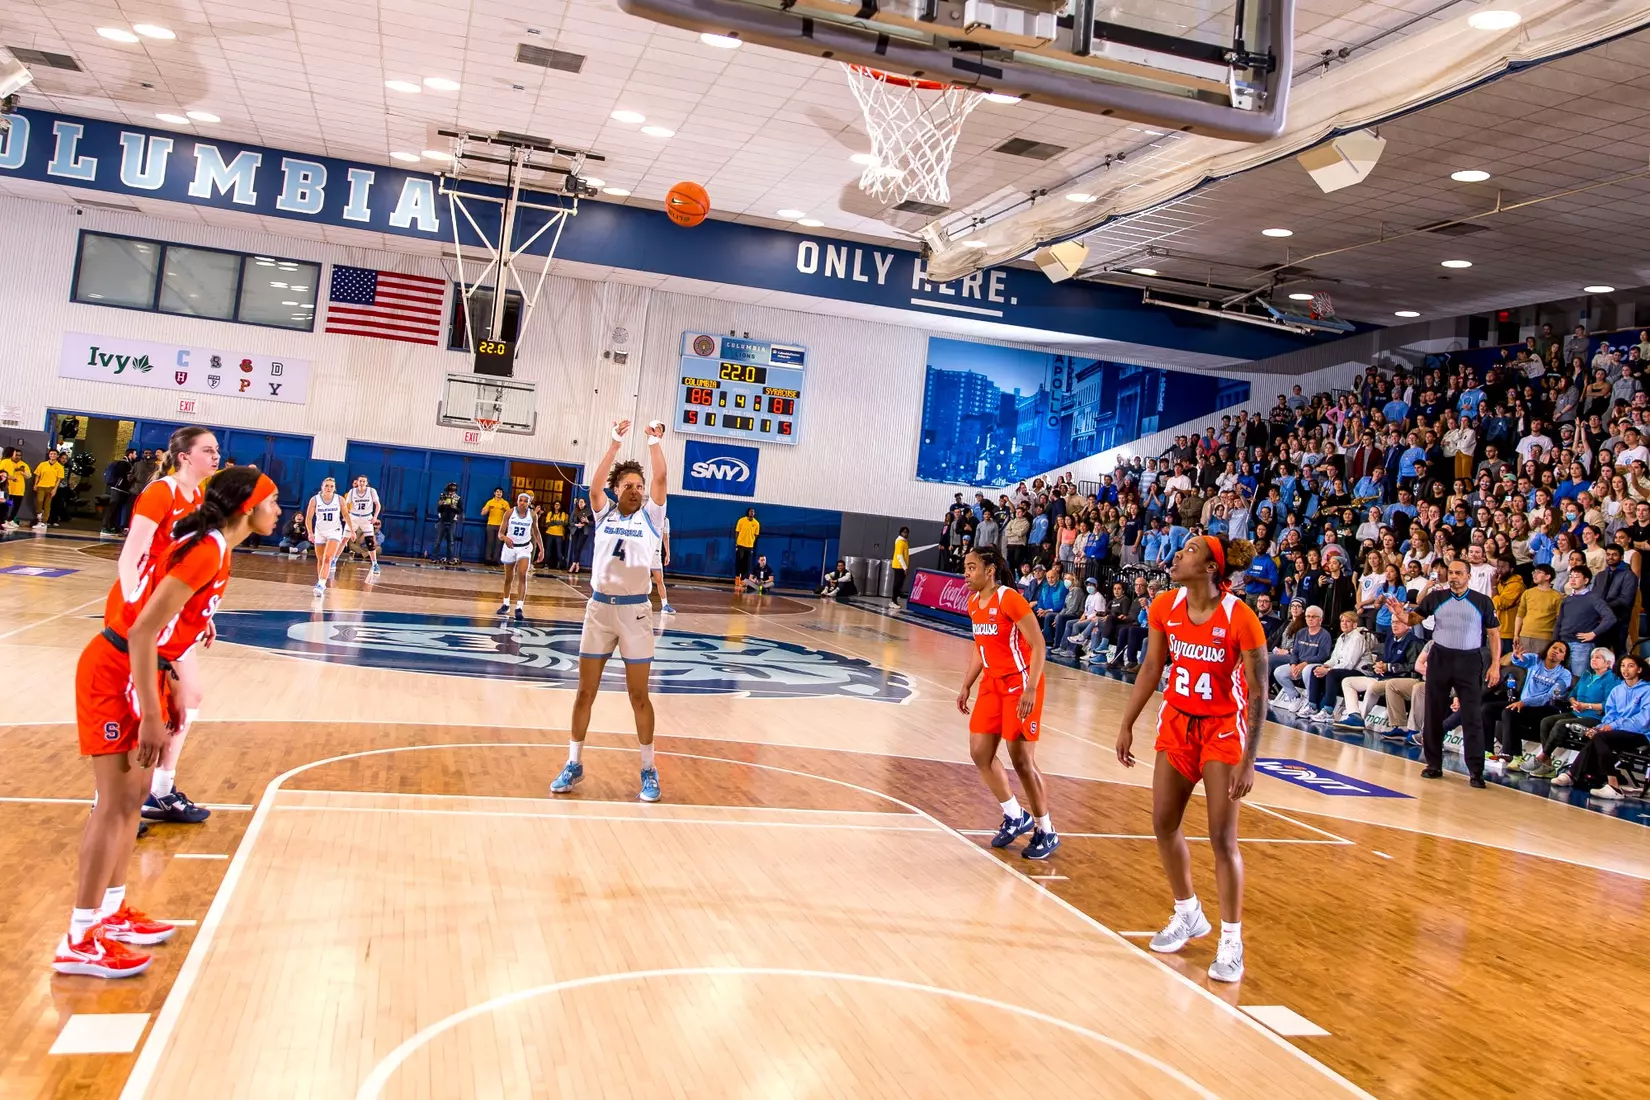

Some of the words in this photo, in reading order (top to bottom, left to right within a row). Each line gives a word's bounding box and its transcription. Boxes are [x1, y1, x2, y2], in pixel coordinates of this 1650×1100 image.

[796, 240, 894, 285] ONLY
[912, 258, 1018, 305] HRE.
[726, 342, 766, 353] COLUMBIA
[87, 346, 131, 374] Ivy
[271, 361, 284, 376] D
[721, 363, 756, 383] 22.0
[239, 378, 251, 392] P
[268, 382, 282, 396] Y
[684, 377, 718, 388] COLUMBIA
[691, 388, 711, 406] 86
[736, 395, 745, 407] 4
[765, 387, 798, 399] SYRACUSE
[179, 400, 196, 412] EXIT
[773, 398, 793, 415] 81
[688, 411, 697, 424] 5
[464, 431, 479, 443] EXIT
[783, 422, 791, 435] 5
[690, 461, 742, 481] SNY
[323, 512, 333, 521] 10
[513, 526, 526, 536] 23
[612, 538, 626, 561] 4
[1169, 633, 1225, 662] Syracuse
[980, 645, 989, 668] 1
[1175, 666, 1212, 700] 24
[103, 721, 121, 741] S
